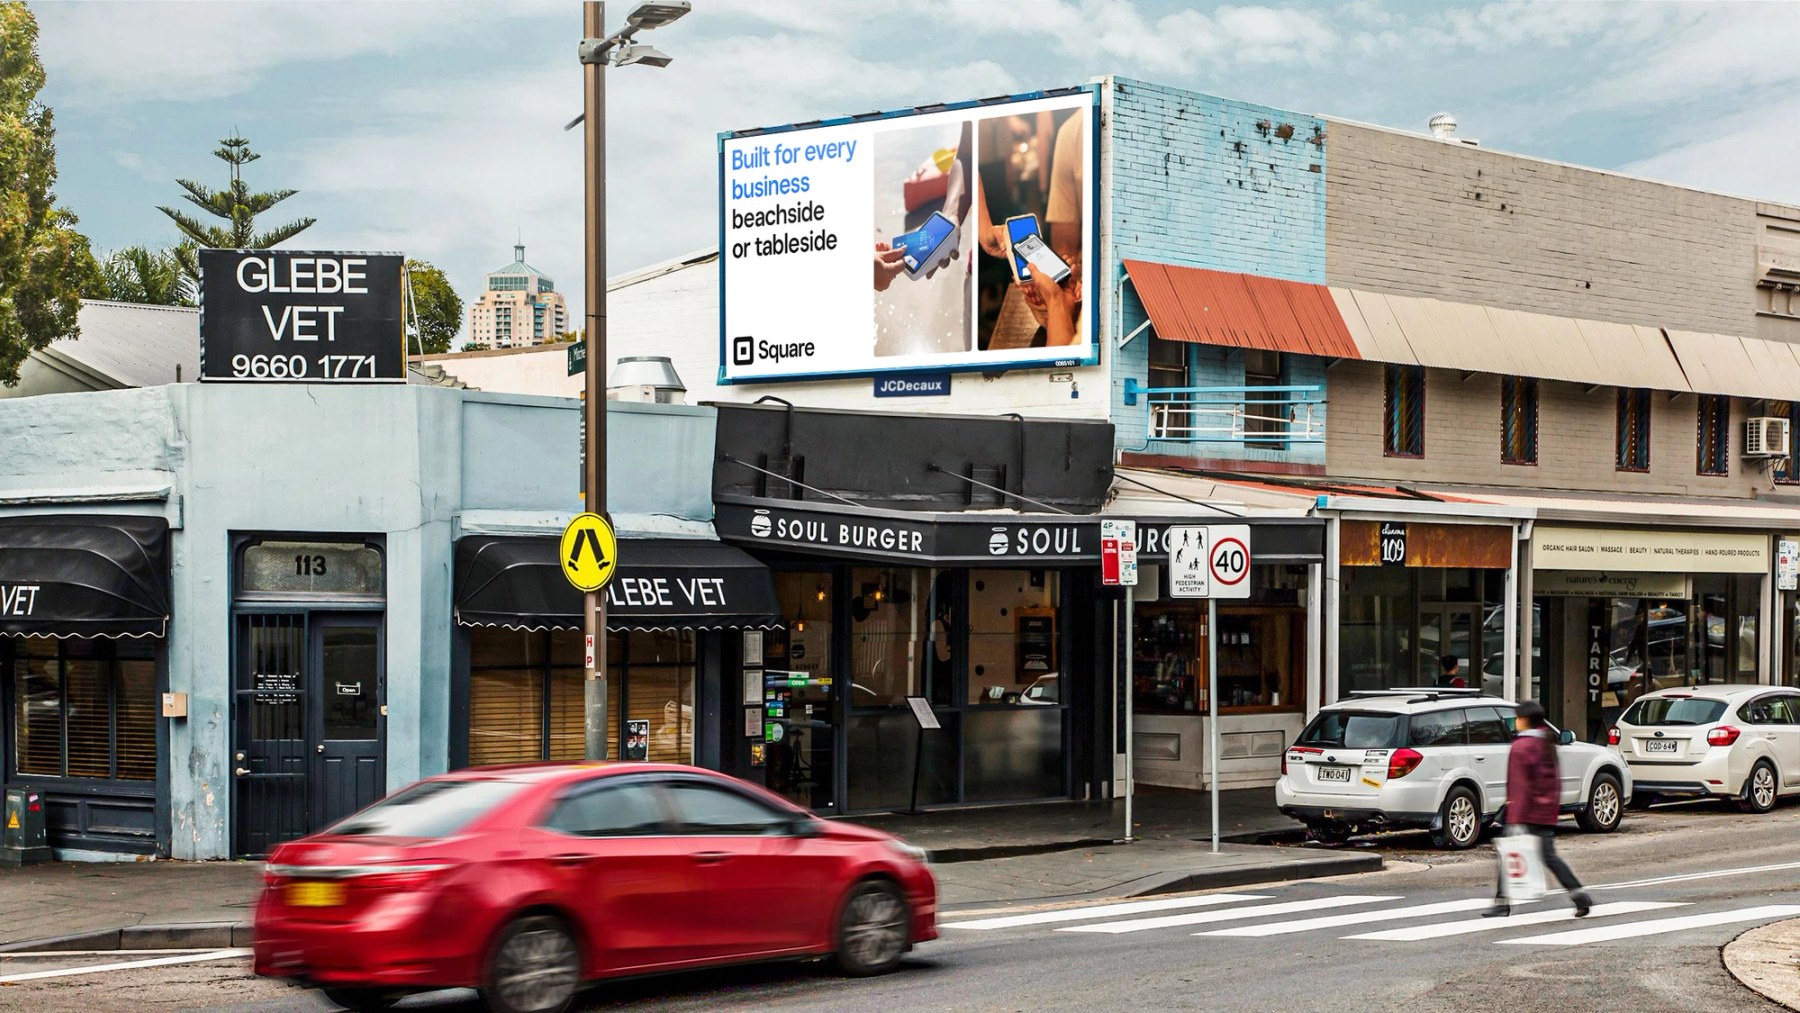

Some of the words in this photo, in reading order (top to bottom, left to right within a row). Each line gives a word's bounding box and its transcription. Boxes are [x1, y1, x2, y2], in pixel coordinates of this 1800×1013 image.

[732, 147, 770, 171] Built
[774, 143, 800, 166] for
[804, 139, 857, 162] every
[732, 174, 810, 200] business
[732, 201, 825, 229] beachside
[732, 241, 751, 259] or
[754, 229, 838, 257] tableside
[236, 257, 368, 294] GLEBE
[261, 305, 344, 342] VET
[758, 338, 815, 364] Square
[232, 354, 307, 378] 9660
[318, 355, 377, 378] 1771
[880, 379, 942, 393] JCDecaux
[777, 518, 829, 543] SOUL
[839, 524, 923, 552] BURGER
[1016, 528, 1081, 554] SOUL
[1542, 544, 1564, 552] ORGANIC
[1215, 550, 1244, 573] 40
[1382, 538, 1405, 562] 109
[295, 555, 327, 576] 113
[606, 578, 674, 606] LEBE
[676, 578, 727, 606] VET
[1608, 577, 1640, 591] energy
[1, 585, 40, 615] VET
[1589, 625, 1602, 702] TAROT
